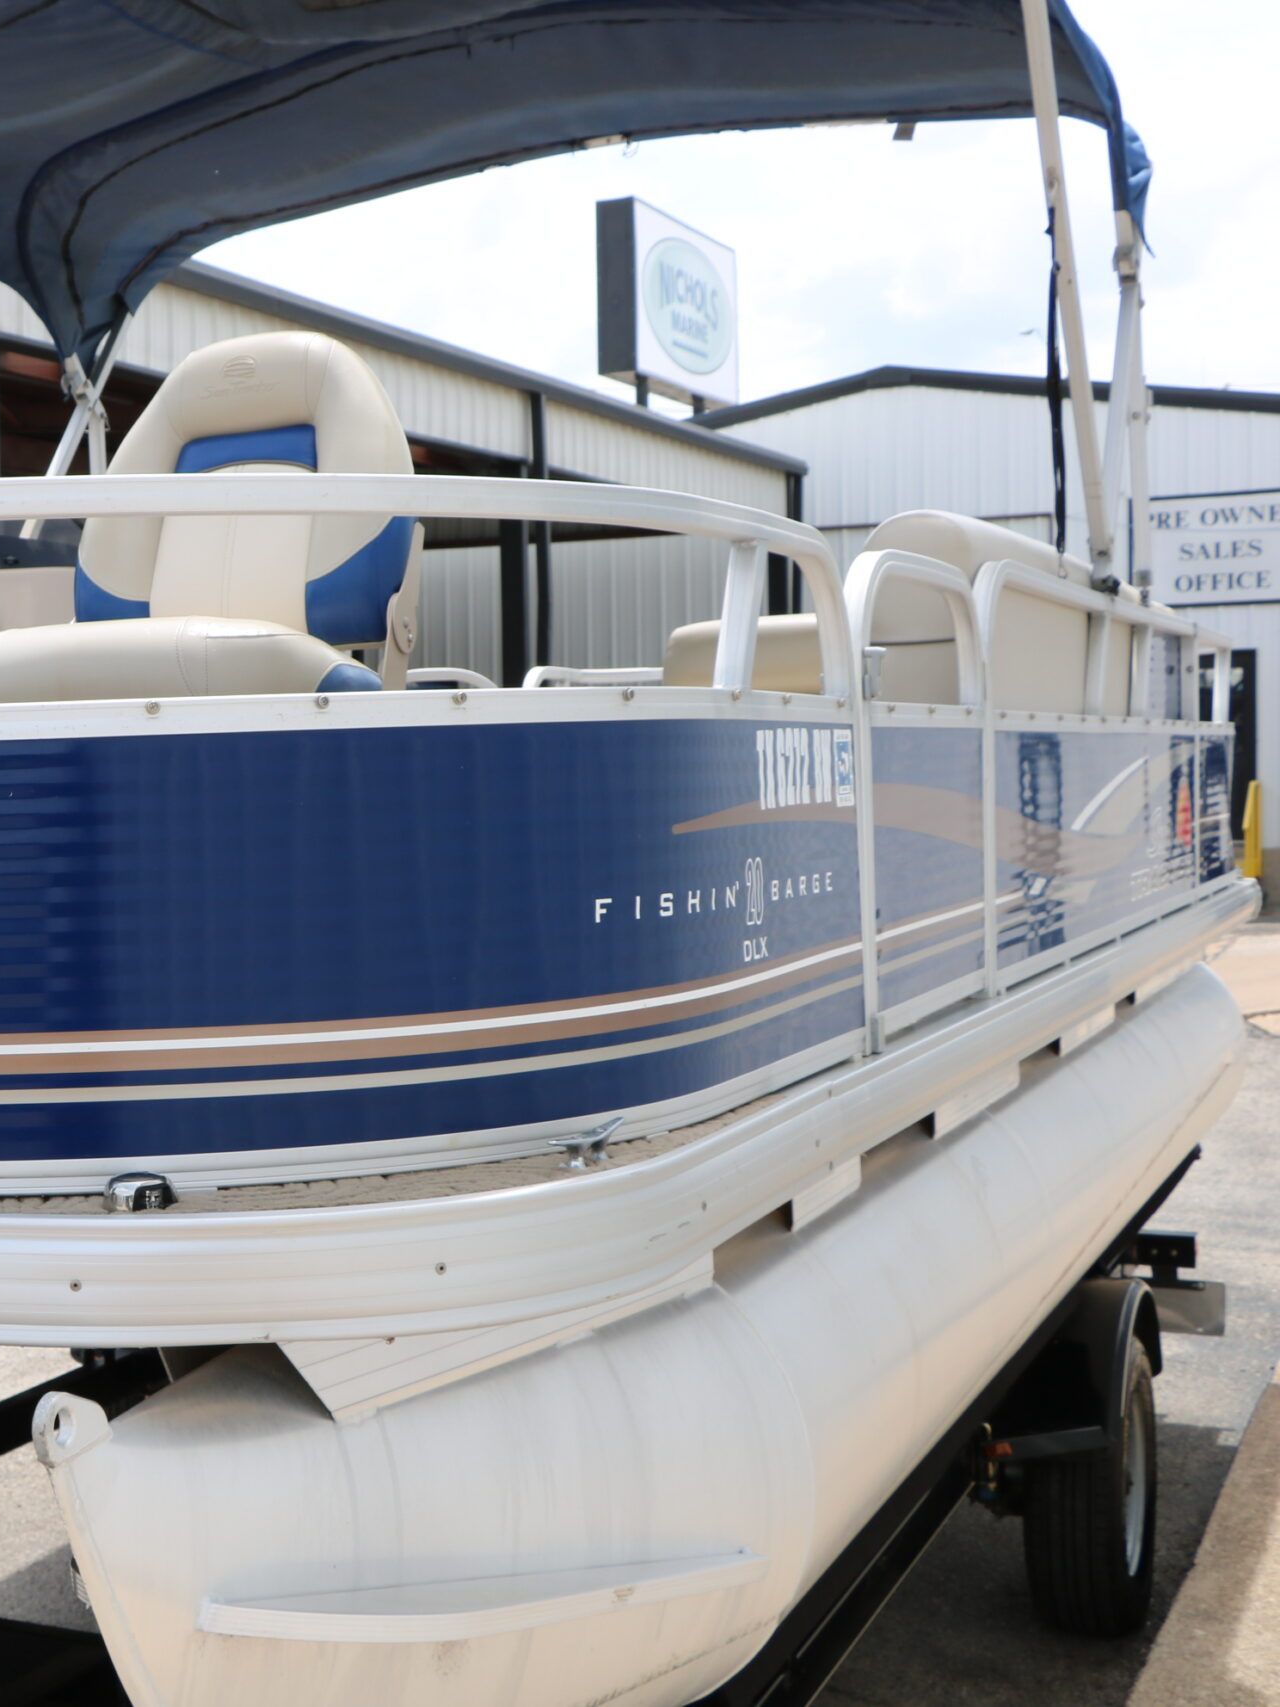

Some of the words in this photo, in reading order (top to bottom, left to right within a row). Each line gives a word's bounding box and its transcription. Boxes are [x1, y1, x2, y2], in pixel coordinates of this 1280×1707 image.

[660, 260, 719, 331] NICHOLS
[1178, 538, 1263, 561] SALES
[1174, 570, 1272, 593] OFFICE
[594, 880, 740, 923] FISHIN'
[744, 856, 764, 926] 20
[771, 871, 833, 901] BARGE
[743, 936, 769, 962] DLX
